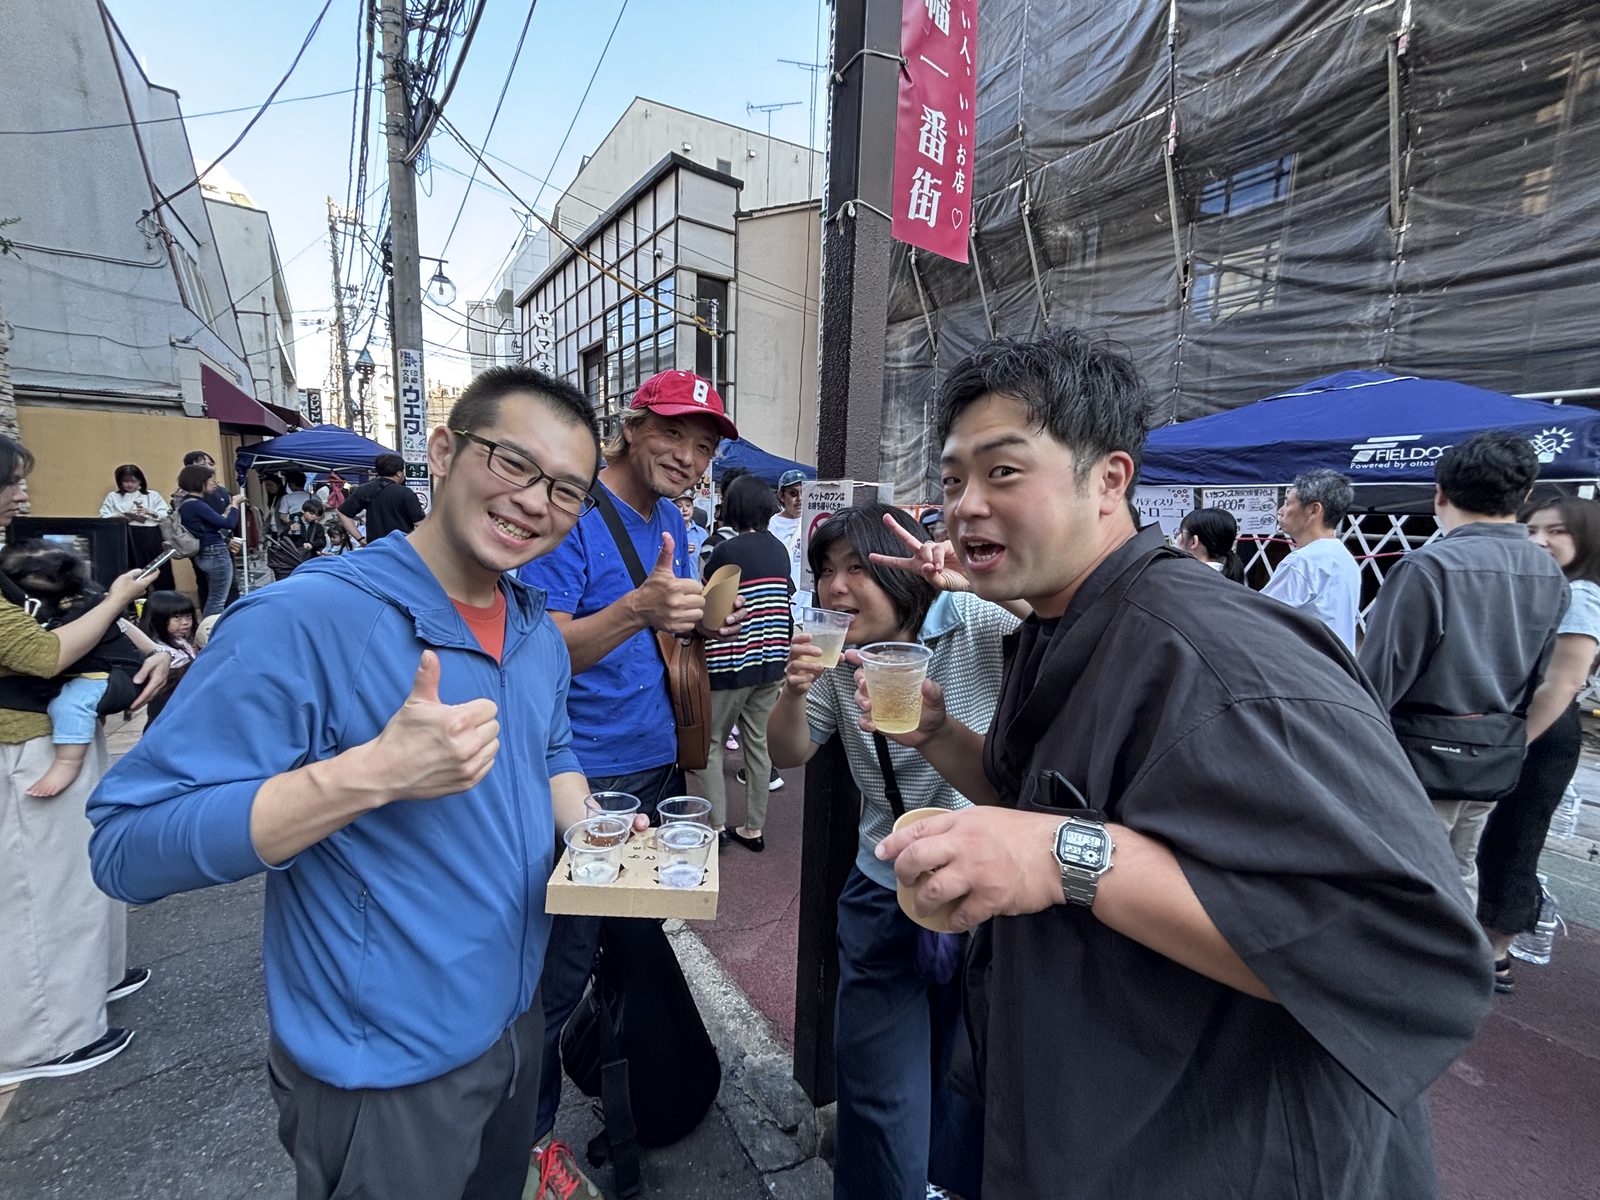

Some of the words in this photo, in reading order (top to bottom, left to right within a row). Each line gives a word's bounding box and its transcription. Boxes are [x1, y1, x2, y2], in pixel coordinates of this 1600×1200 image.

[538, 314, 551, 372] ヤマネ
[1350, 461, 1390, 469] Powered
[1394, 461, 1407, 469] by
[808, 492, 845, 501] ペットのフンは
